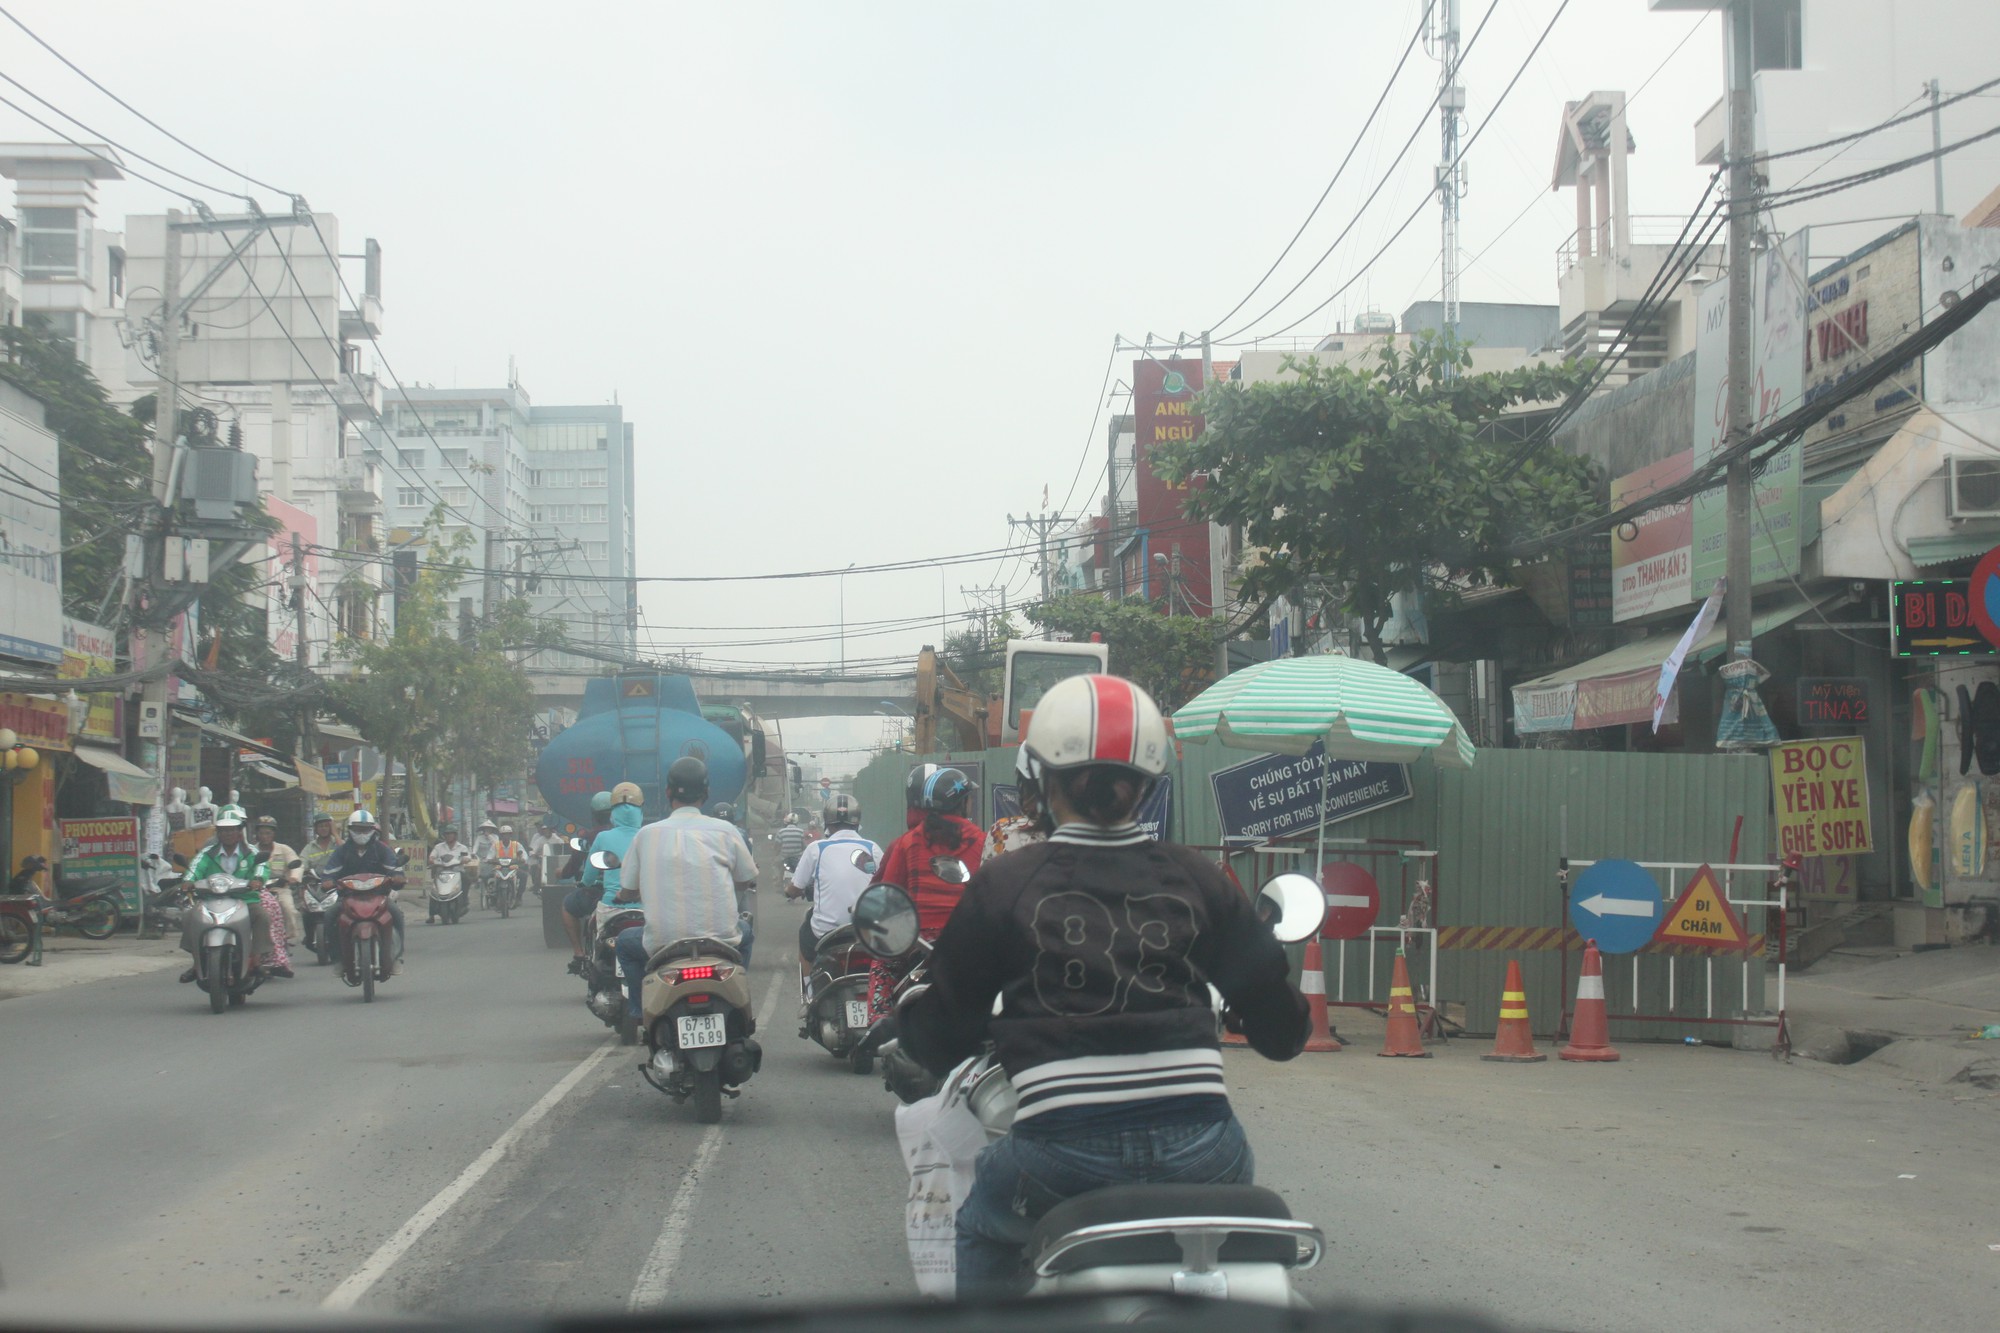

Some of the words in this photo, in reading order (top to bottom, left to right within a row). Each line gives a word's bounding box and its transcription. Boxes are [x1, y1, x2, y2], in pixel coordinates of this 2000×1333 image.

[1154, 420, 1195, 440] NGỮ
[1637, 558, 1666, 588] THANH
[1681, 552, 1687, 575] 3
[1905, 592, 1936, 628] BI
[1945, 592, 1975, 628] D
[1803, 700, 1851, 720] TINA
[1854, 701, 1867, 721] 2
[1250, 765, 1293, 790] CHÚNG
[1294, 756, 1315, 775] TÔI
[1781, 743, 1853, 778] BỌC
[1249, 791, 1265, 811] VỀ
[1269, 788, 1285, 805] SỰ
[1288, 778, 1311, 801] BẤT
[1344, 760, 1369, 779] NÀY
[1781, 776, 1826, 813] YÊN
[1831, 778, 1860, 810] XE
[64, 821, 133, 838] PHOTOCOPY
[1241, 819, 1272, 837] SORRY
[1274, 813, 1293, 831] FOR
[1293, 804, 1315, 822] THIS
[1781, 813, 1817, 855] GHẾ
[1821, 819, 1867, 851] SOFA
[1834, 854, 1850, 895] 2
[1696, 899, 1710, 912] ĐI
[1681, 917, 1722, 936] CHẬM
[681, 1030, 723, 1046] 516.89
[685, 1016, 716, 1031] 67-B1
